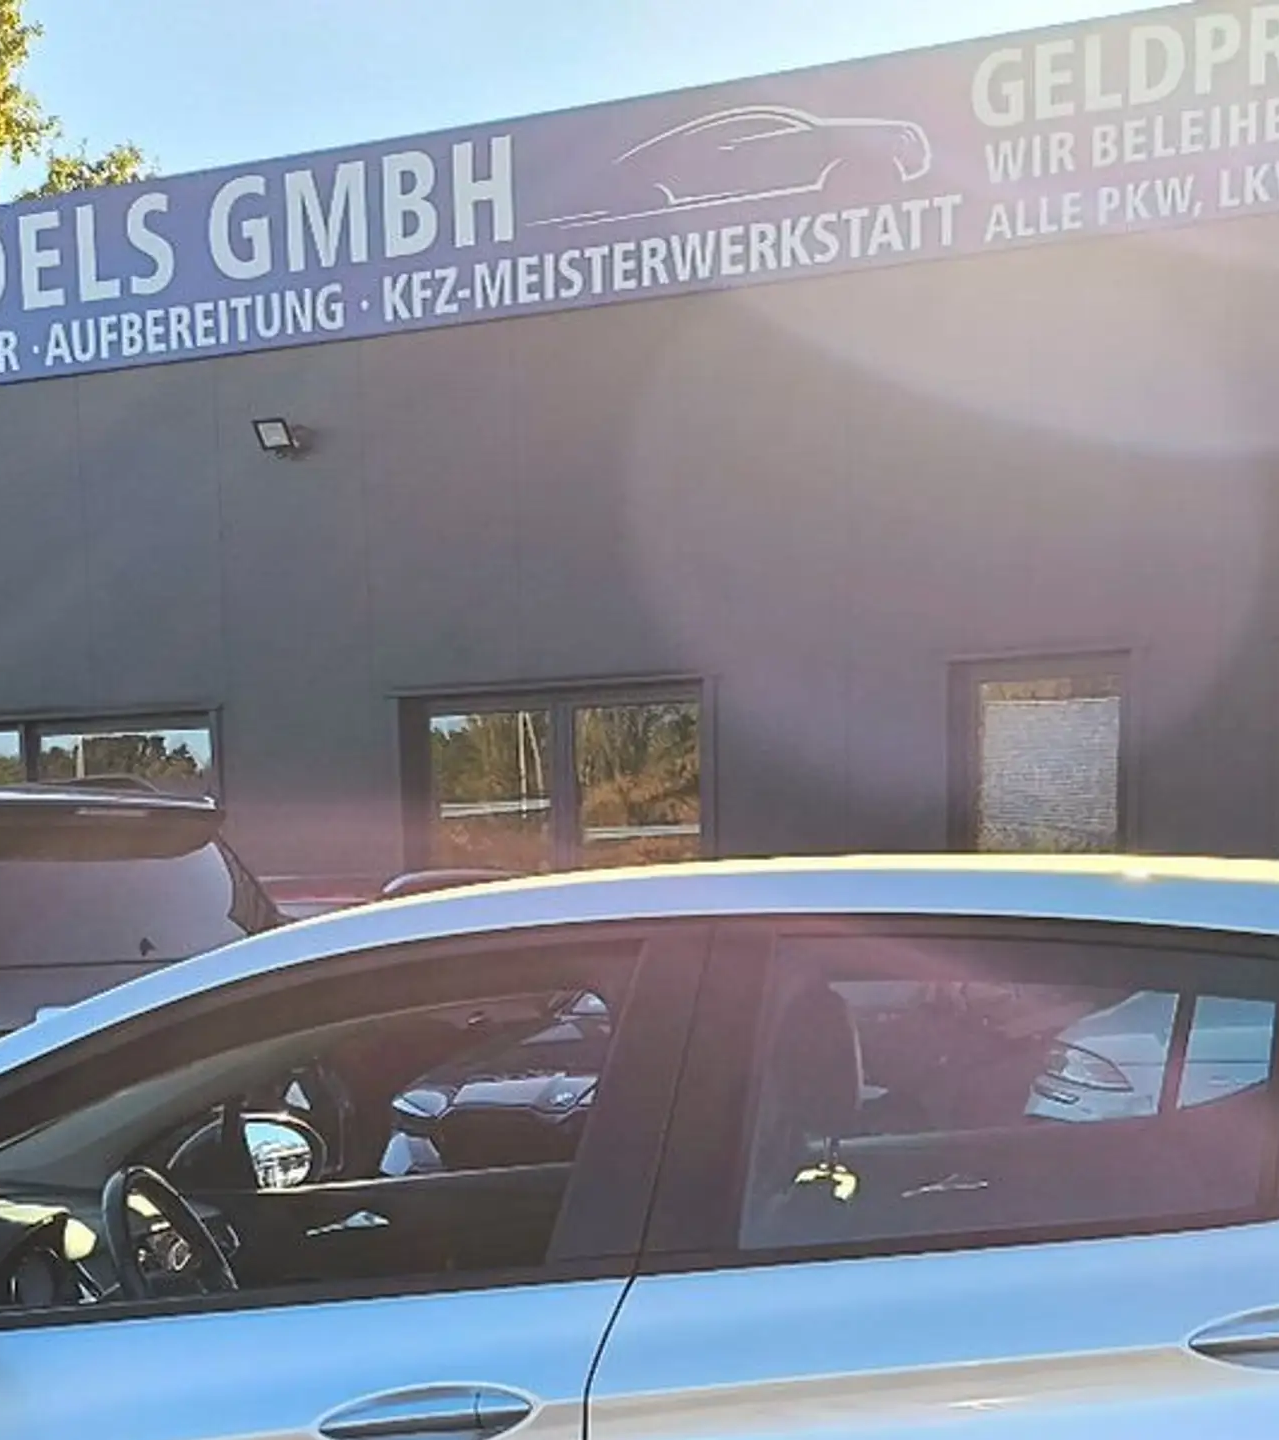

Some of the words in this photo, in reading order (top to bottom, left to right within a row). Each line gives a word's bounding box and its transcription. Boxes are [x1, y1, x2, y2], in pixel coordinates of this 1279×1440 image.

[208, 134, 515, 282] GMBH
[984, 191, 1083, 244] ALLE
[1097, 175, 1202, 226] PKW,
[985, 131, 1075, 185] WIR
[45, 282, 345, 367] AUFBEREITUNG
[382, 194, 963, 324] KFZ-MEISTERWERKSTATT
